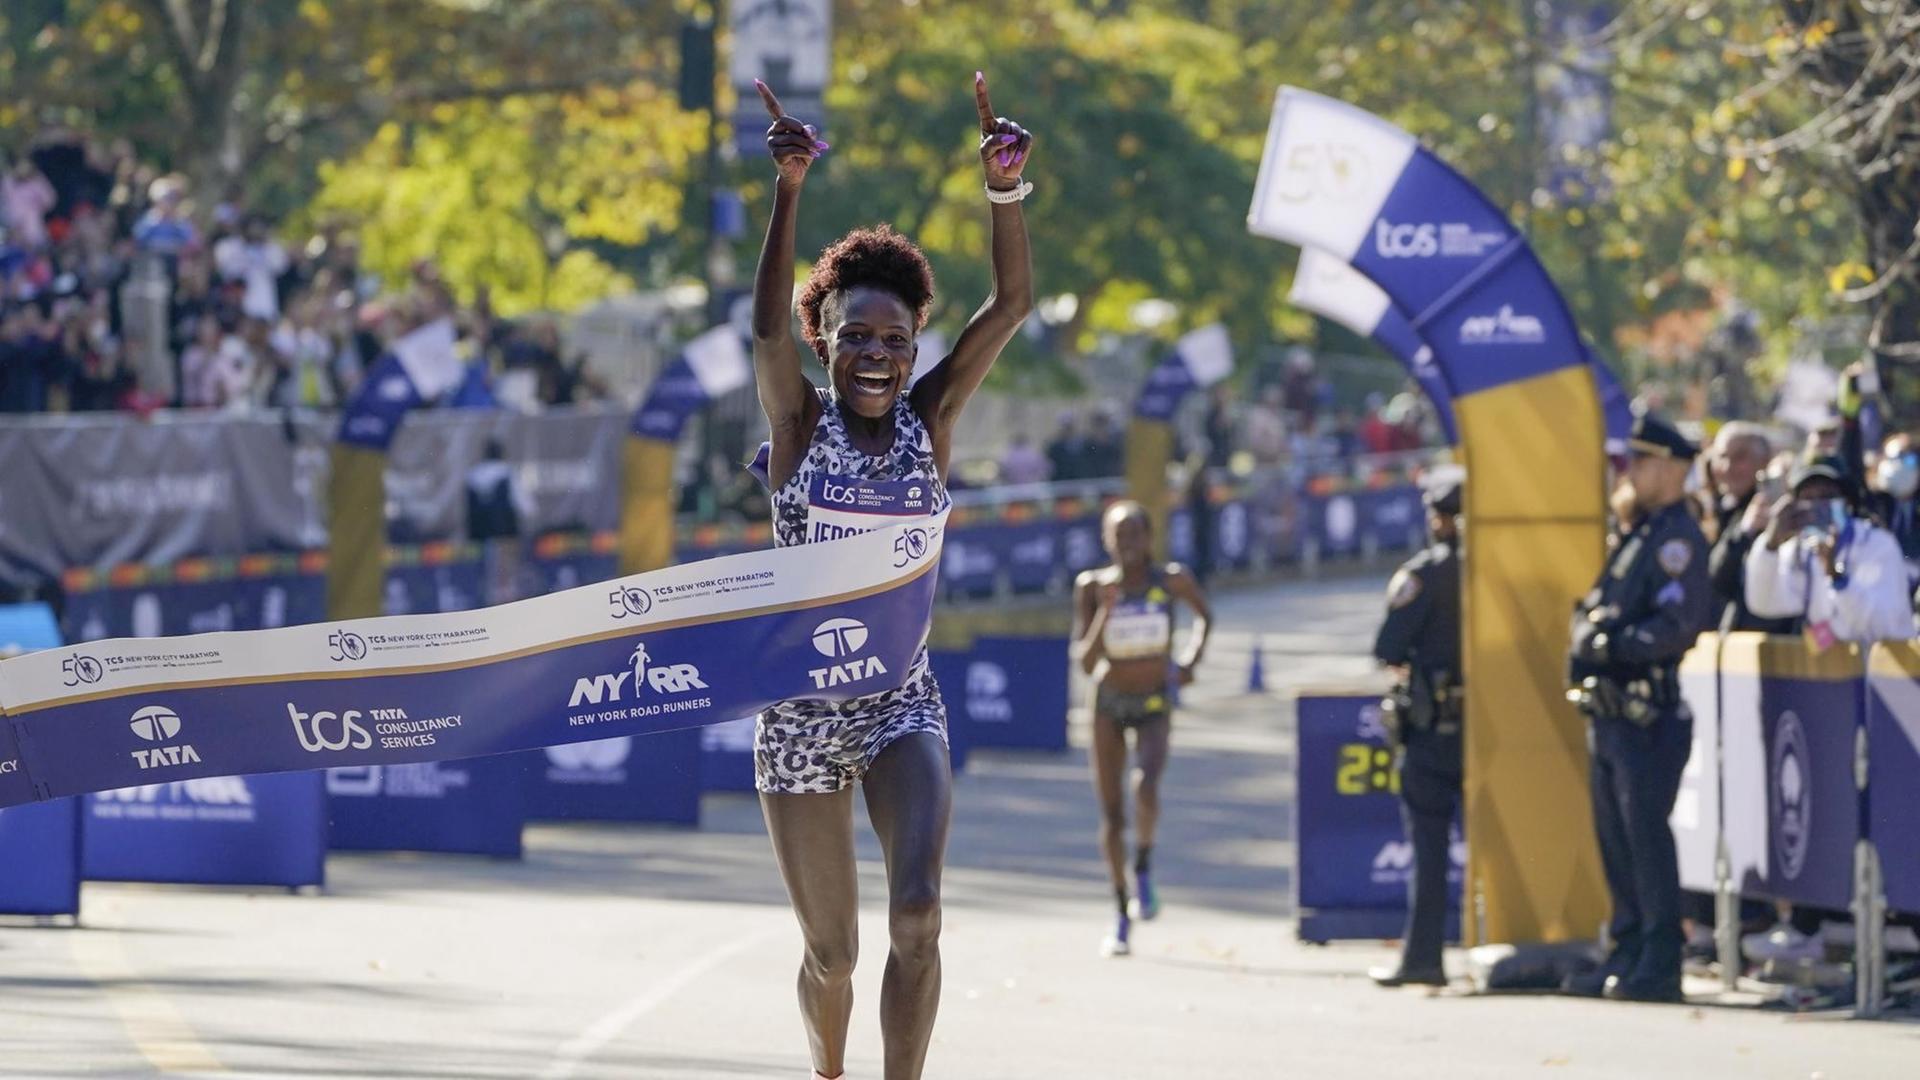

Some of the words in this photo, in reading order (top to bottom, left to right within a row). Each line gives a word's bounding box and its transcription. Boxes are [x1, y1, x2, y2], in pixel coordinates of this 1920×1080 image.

[823, 479, 856, 504] tcs
[858, 494, 895, 502] CONSULTANCY
[904, 500, 923, 508] TATA
[653, 586, 674, 596] TCS
[675, 584, 694, 593] NEW
[695, 580, 716, 589] YORK
[717, 577, 734, 586] CITY
[735, 571, 774, 582] MARATHON
[368, 635, 386, 644] TCS
[425, 632, 442, 640] CITY
[443, 627, 487, 638] MARATHON
[104, 656, 124, 665] TCS
[179, 650, 220, 660] MARATHON
[808, 656, 887, 689] TATA
[369, 708, 408, 721] TATA
[569, 713, 595, 726] NEW
[598, 709, 627, 722] YORK
[630, 705, 660, 717] ROAD
[663, 697, 711, 713] RUNNERS
[287, 702, 372, 752] tcs
[375, 715, 462, 735] CONSULTANCY
[380, 733, 436, 749] SERVICES
[131, 745, 201, 769] TATA
